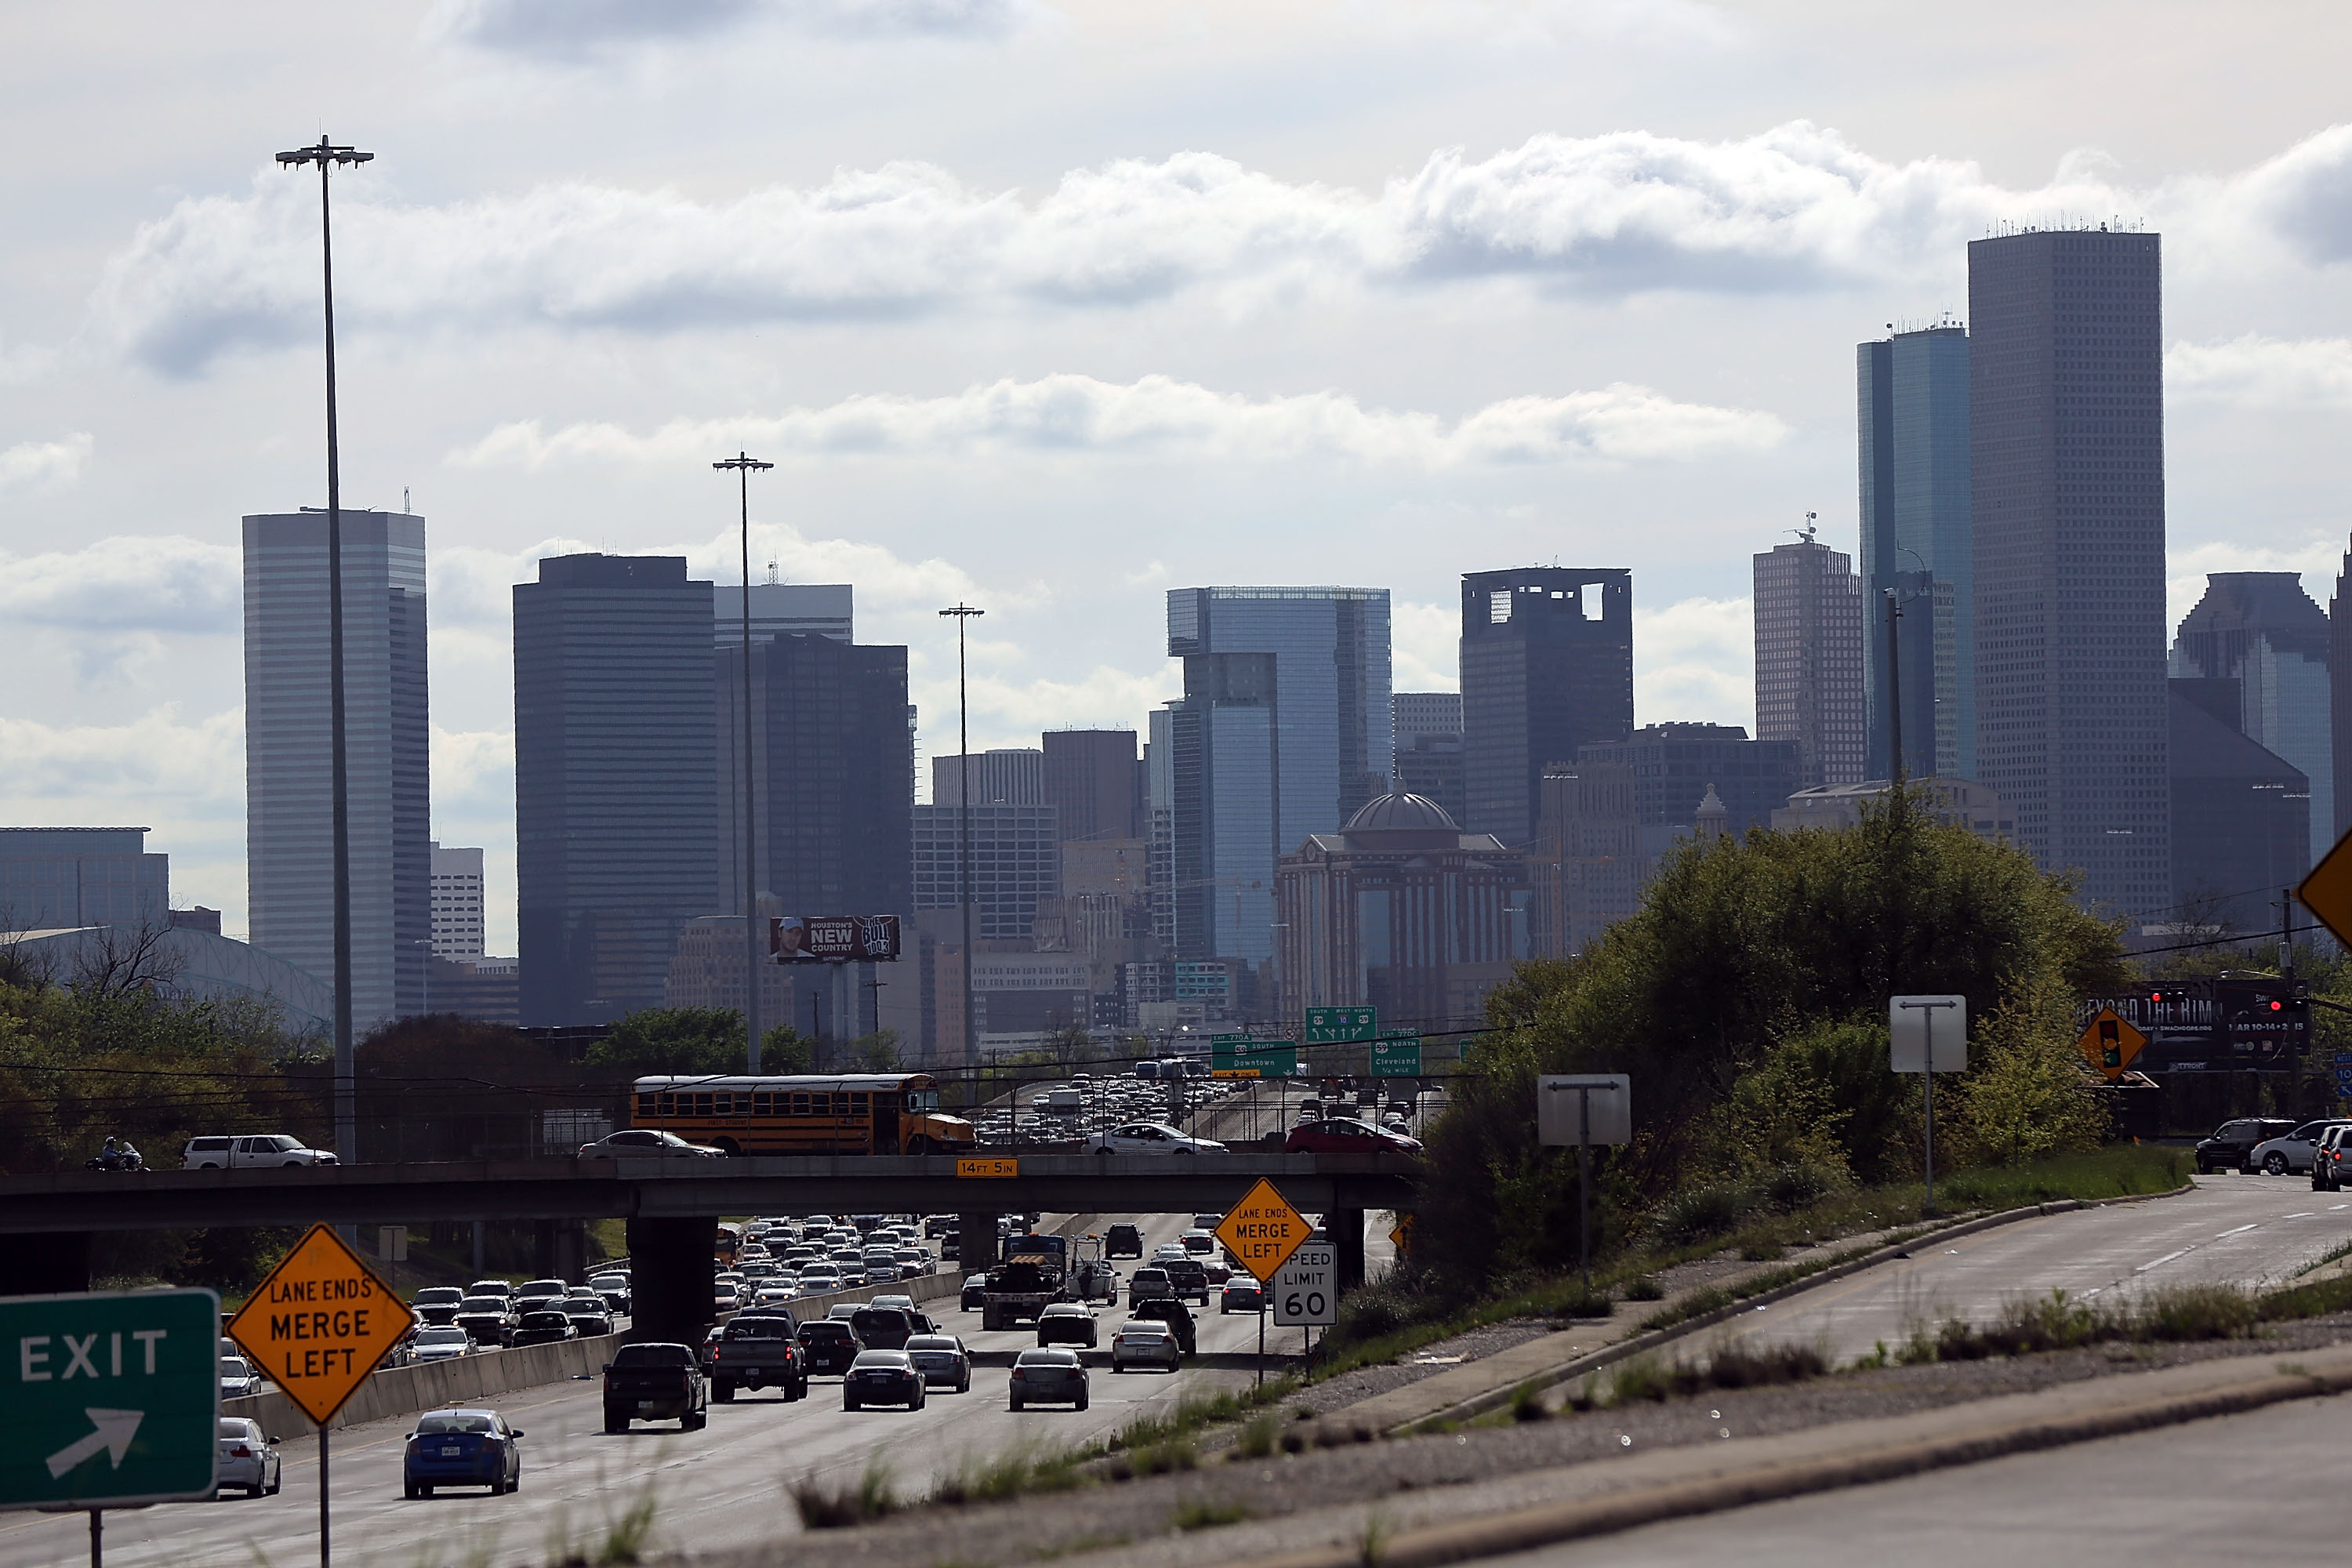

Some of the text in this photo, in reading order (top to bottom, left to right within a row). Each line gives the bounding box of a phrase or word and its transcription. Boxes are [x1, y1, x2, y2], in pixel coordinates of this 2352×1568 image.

[866, 917, 880, 927] THE
[811, 929, 852, 944] NEW
[862, 924, 890, 946] BULL
[811, 943, 853, 952] COUNTRY
[867, 942, 889, 956] 100.3
[2339, 1069, 2352, 1079] 10
[1239, 1208, 1287, 1219] LANE ENDS
[1236, 1223, 1290, 1239] MERGE
[1243, 1243, 1282, 1258] LEFT
[1289, 1254, 1330, 1265] PEED
[1284, 1272, 1325, 1285] LIMIT
[270, 1278, 372, 1304] LANE ENDS
[1285, 1292, 1326, 1316] 60
[271, 1309, 371, 1341] MERGE
[20, 1329, 167, 1382] EXIT
[286, 1348, 356, 1378] LEFT
